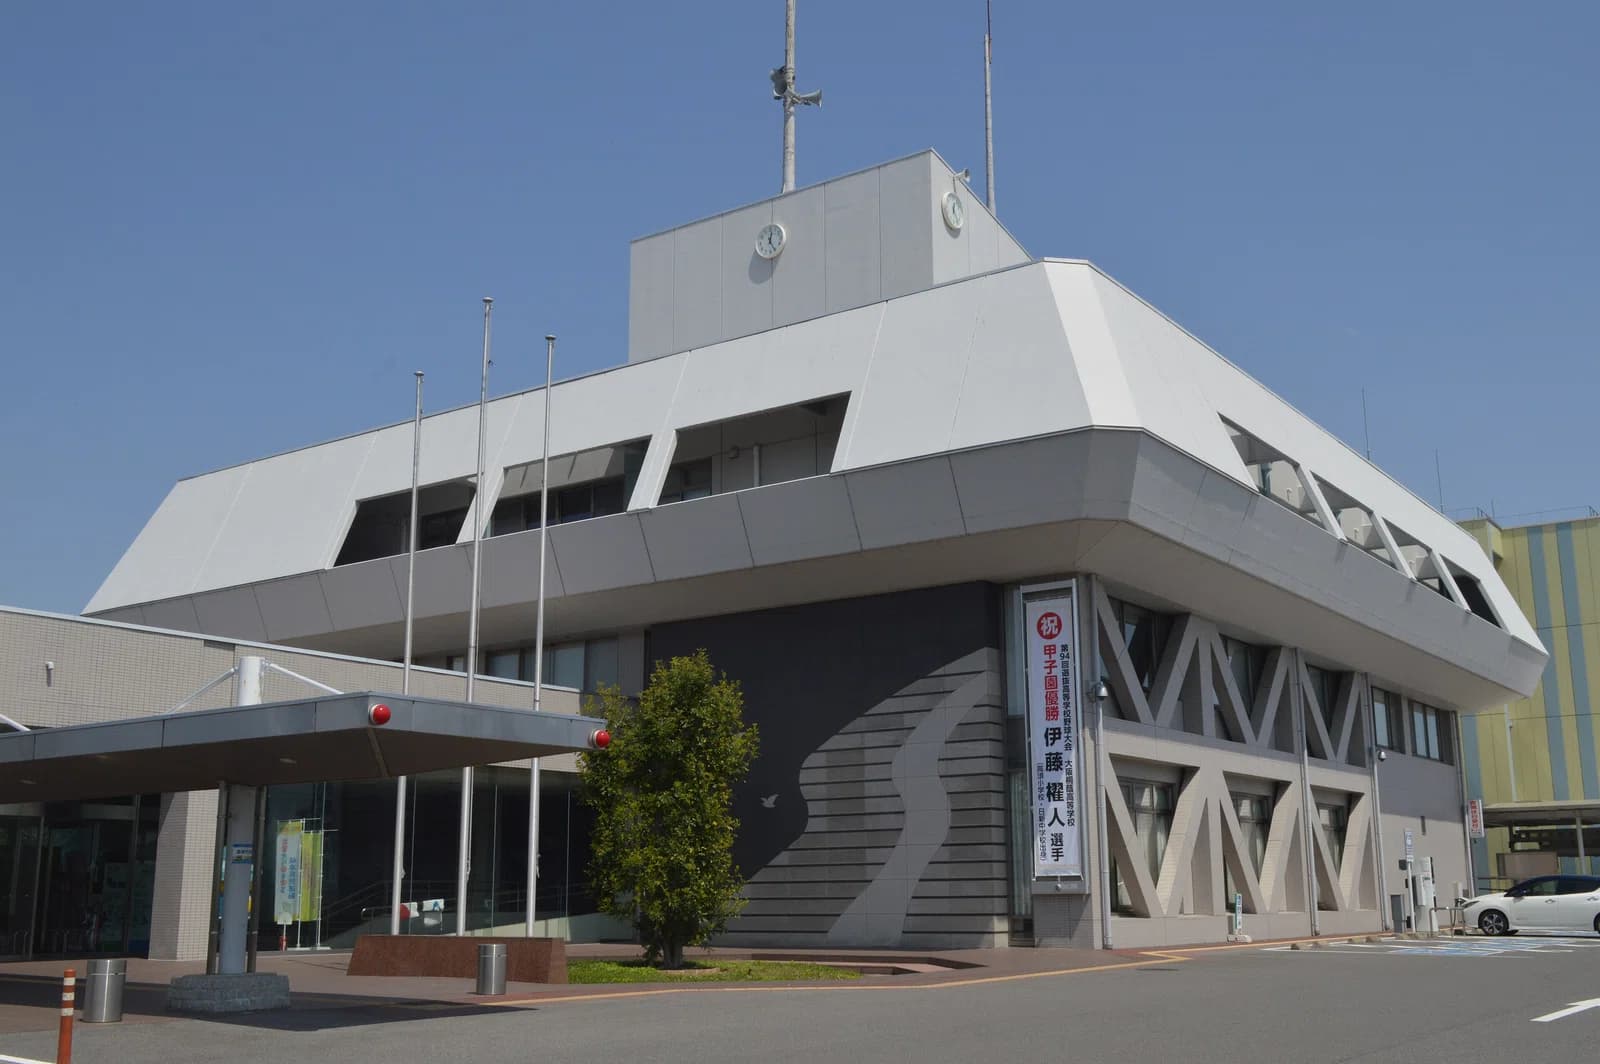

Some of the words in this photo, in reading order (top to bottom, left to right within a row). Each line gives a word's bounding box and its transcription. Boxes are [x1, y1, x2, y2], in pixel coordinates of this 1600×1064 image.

[1041, 616, 1059, 636] 祝
[1043, 644, 1060, 721] 甲子園優勝
